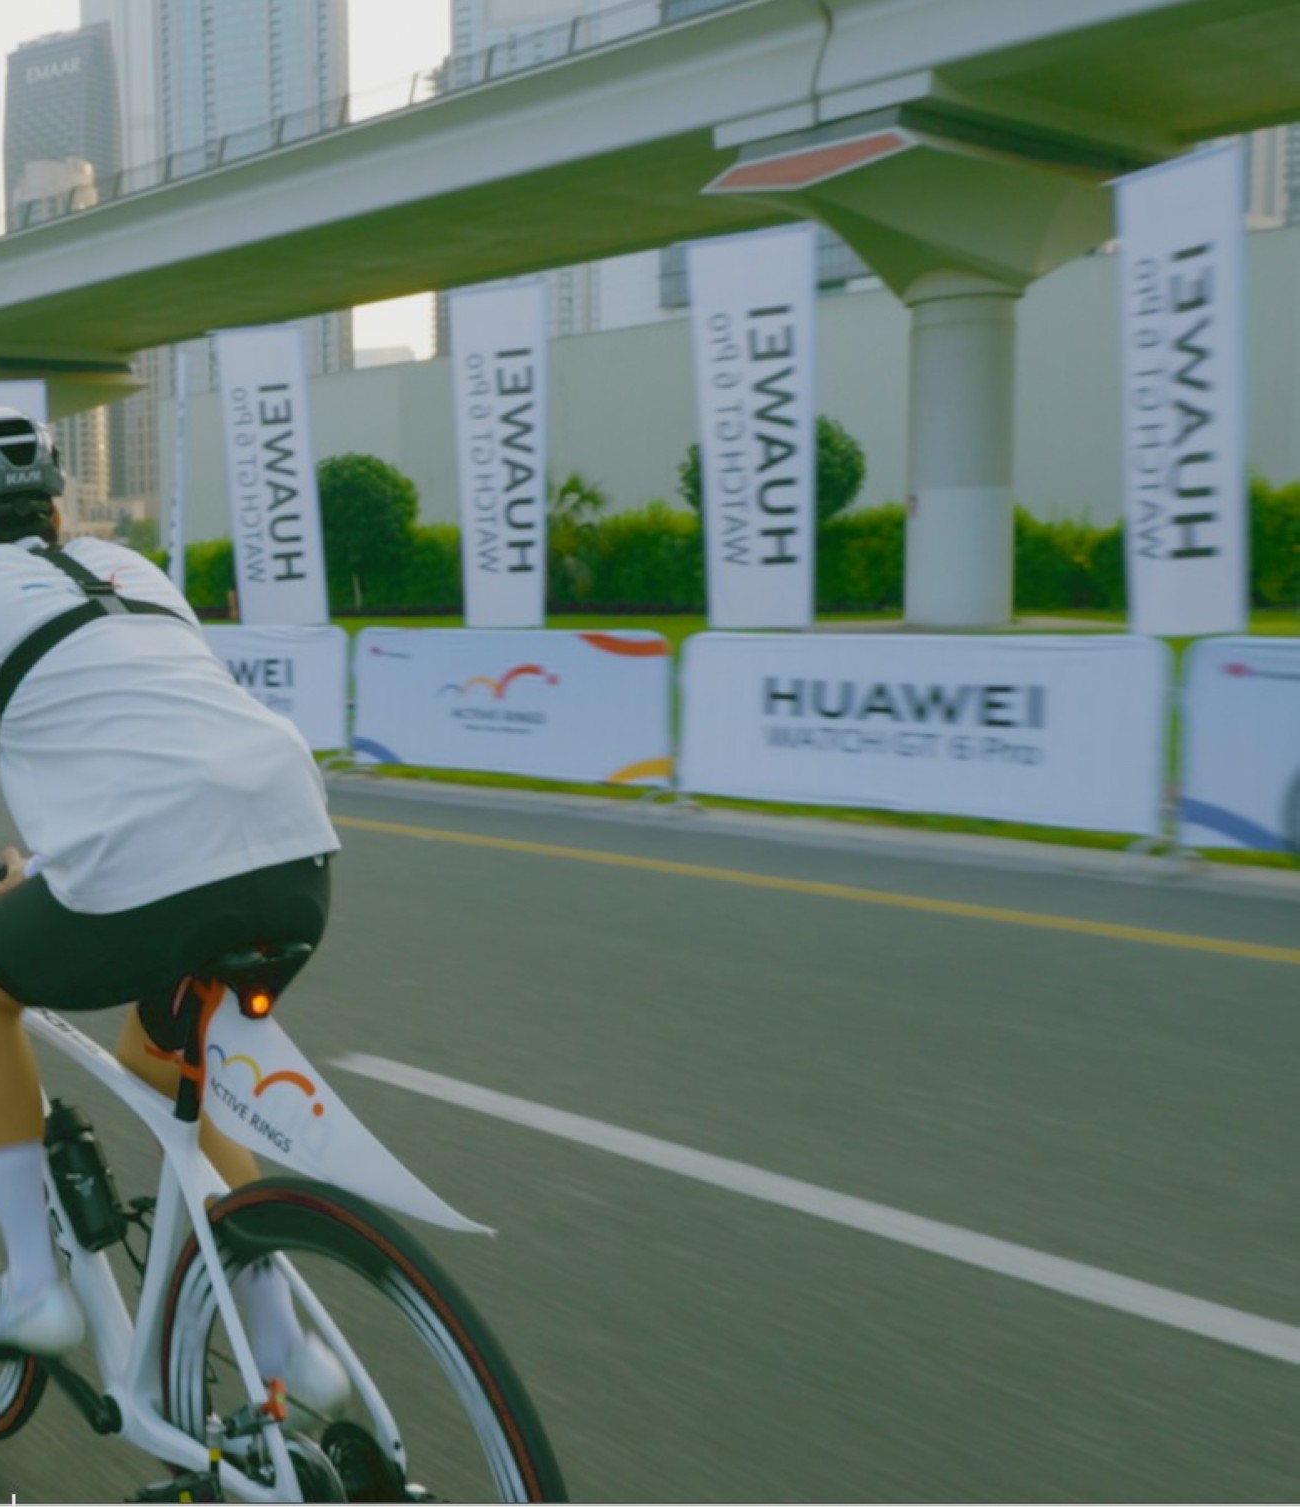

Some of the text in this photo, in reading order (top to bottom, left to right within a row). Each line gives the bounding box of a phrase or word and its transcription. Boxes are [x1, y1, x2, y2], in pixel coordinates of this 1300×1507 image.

[26, 56, 82, 84] EMAAR
[226, 658, 294, 687] WEI
[762, 676, 1047, 729] HUAWEI
[762, 725, 1045, 767] WATCH GT 6 Pro
[249, 1113, 293, 1154] RINGS
